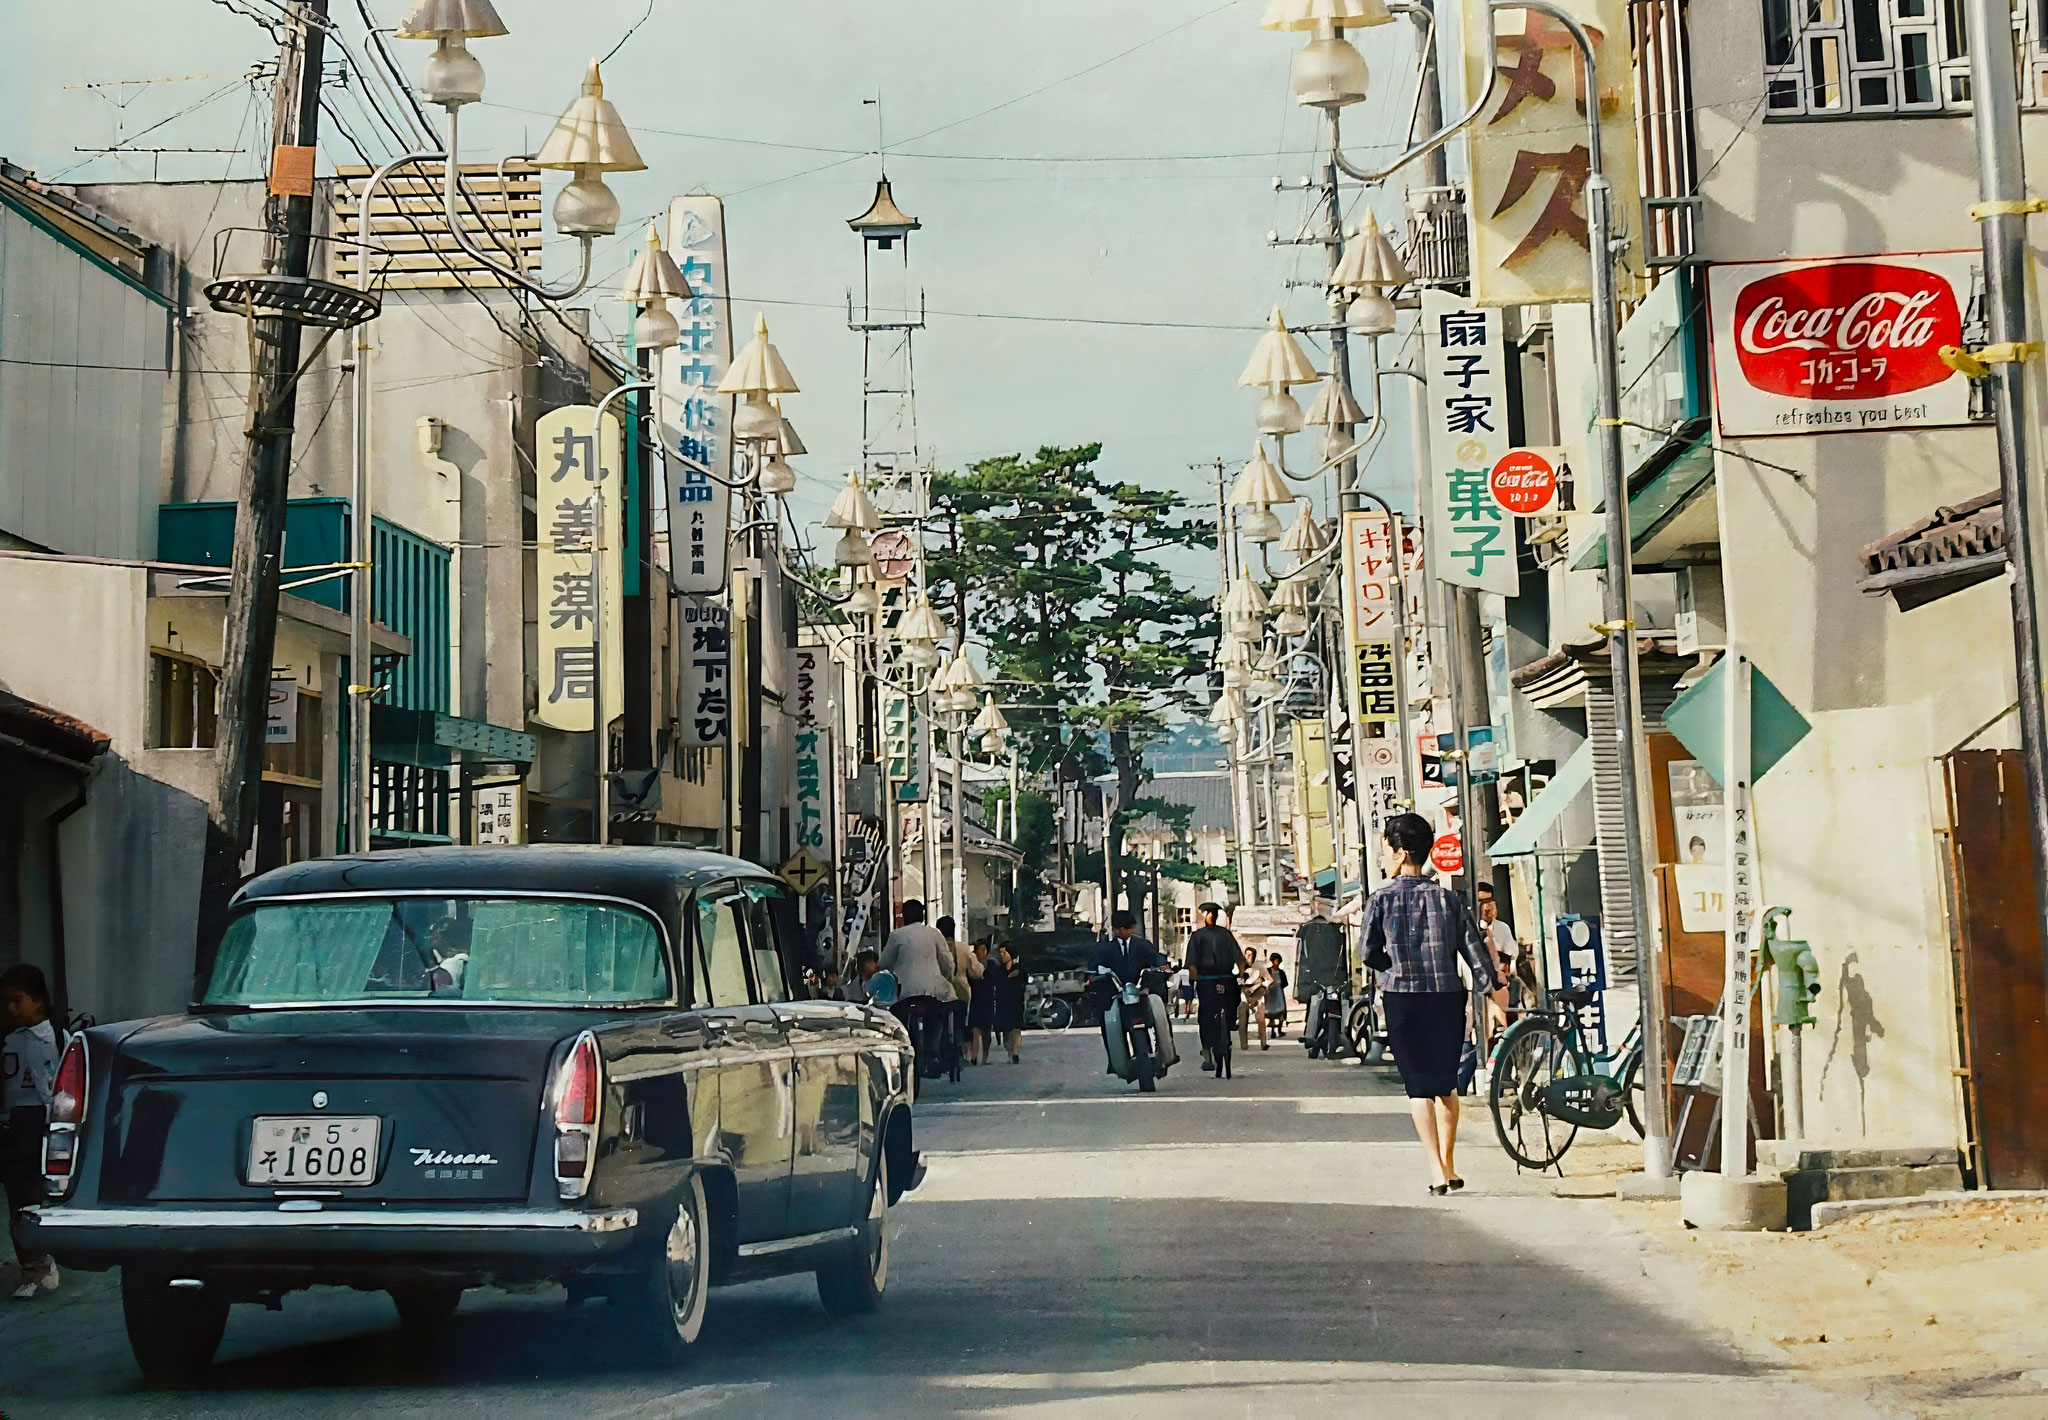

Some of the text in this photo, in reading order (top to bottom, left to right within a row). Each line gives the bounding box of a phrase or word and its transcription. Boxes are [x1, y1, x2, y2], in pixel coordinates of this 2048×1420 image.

[1741, 290, 1940, 354] Coca-Cola
[1859, 409, 1887, 426] you
[326, 1124, 342, 1144] 5
[284, 1146, 366, 1176] 1608
